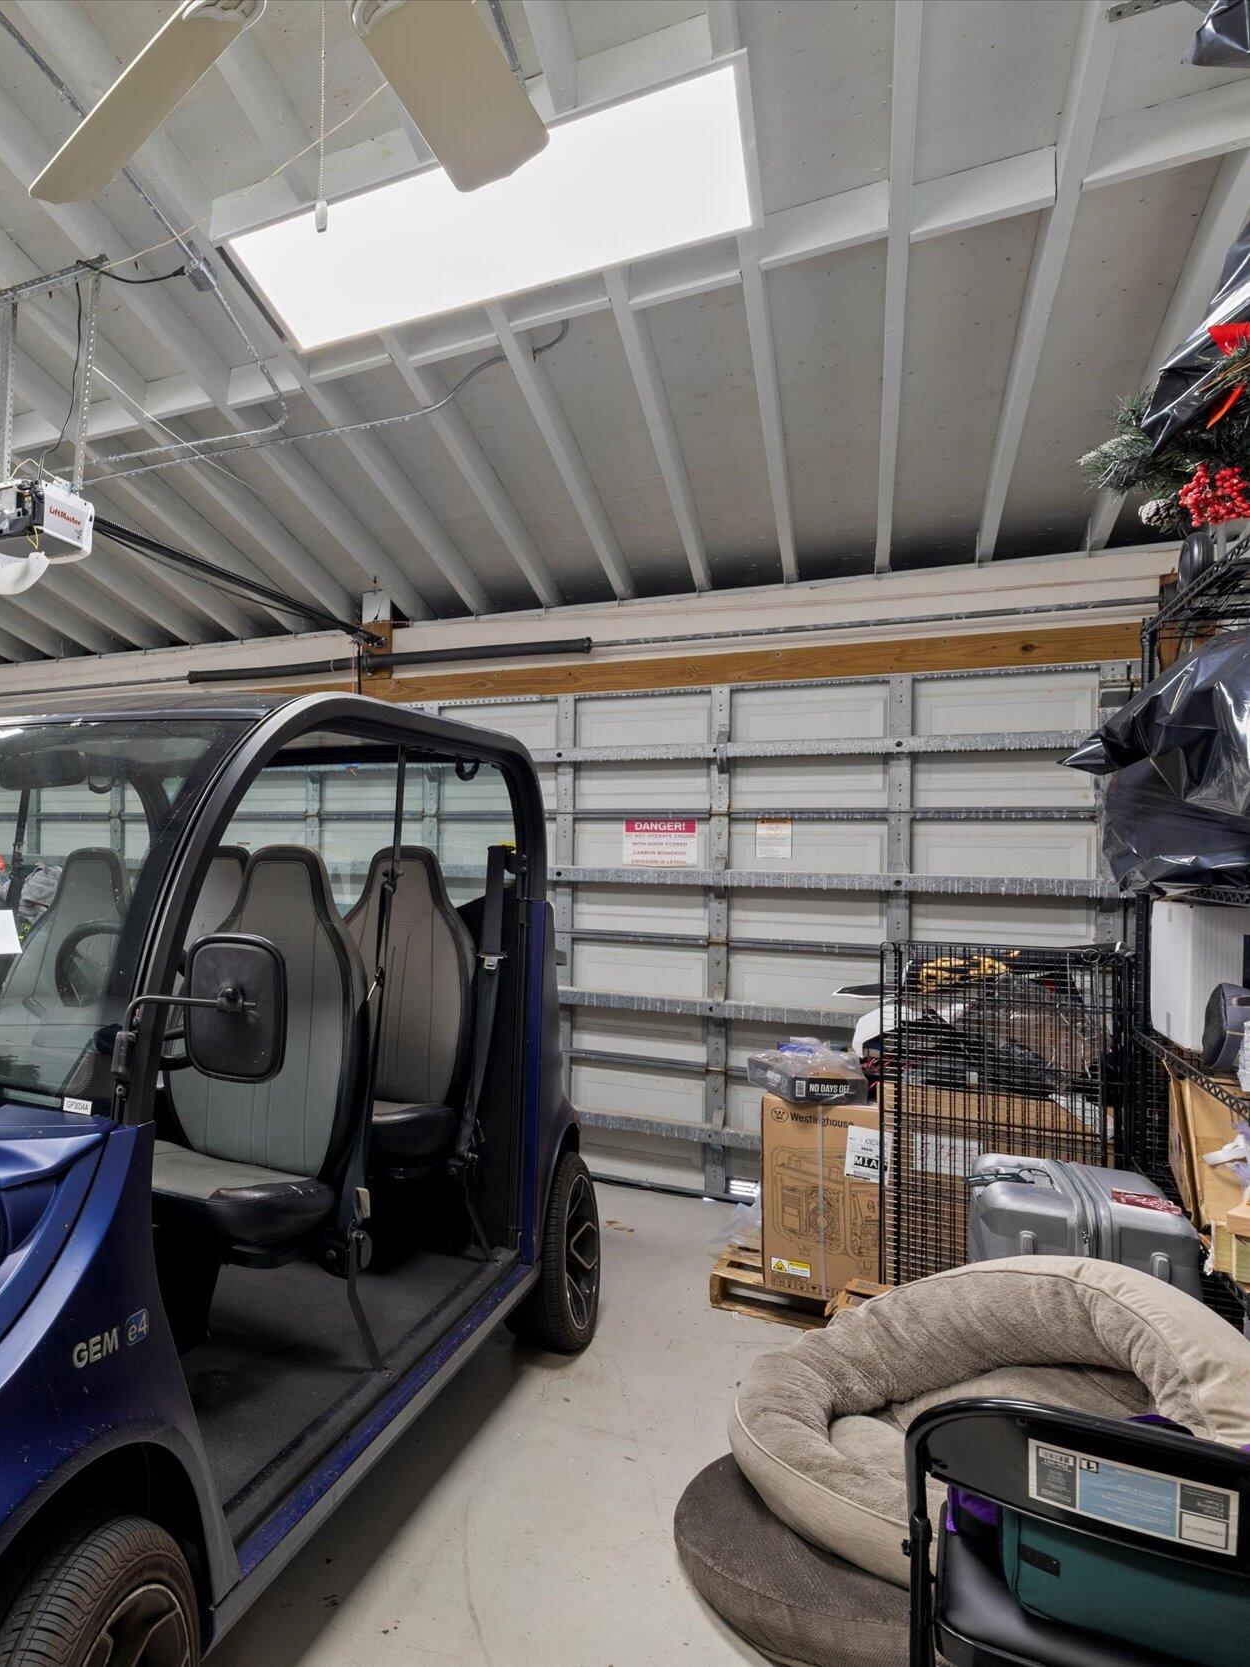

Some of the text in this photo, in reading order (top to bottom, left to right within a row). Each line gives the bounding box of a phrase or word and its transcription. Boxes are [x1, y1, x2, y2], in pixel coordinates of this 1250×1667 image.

[49, 506, 81, 526] LiftMaster
[635, 821, 686, 831] DANGER!
[809, 1083, 851, 1094] NO DAYS OFF
[73, 1312, 148, 1369] GEM e4
